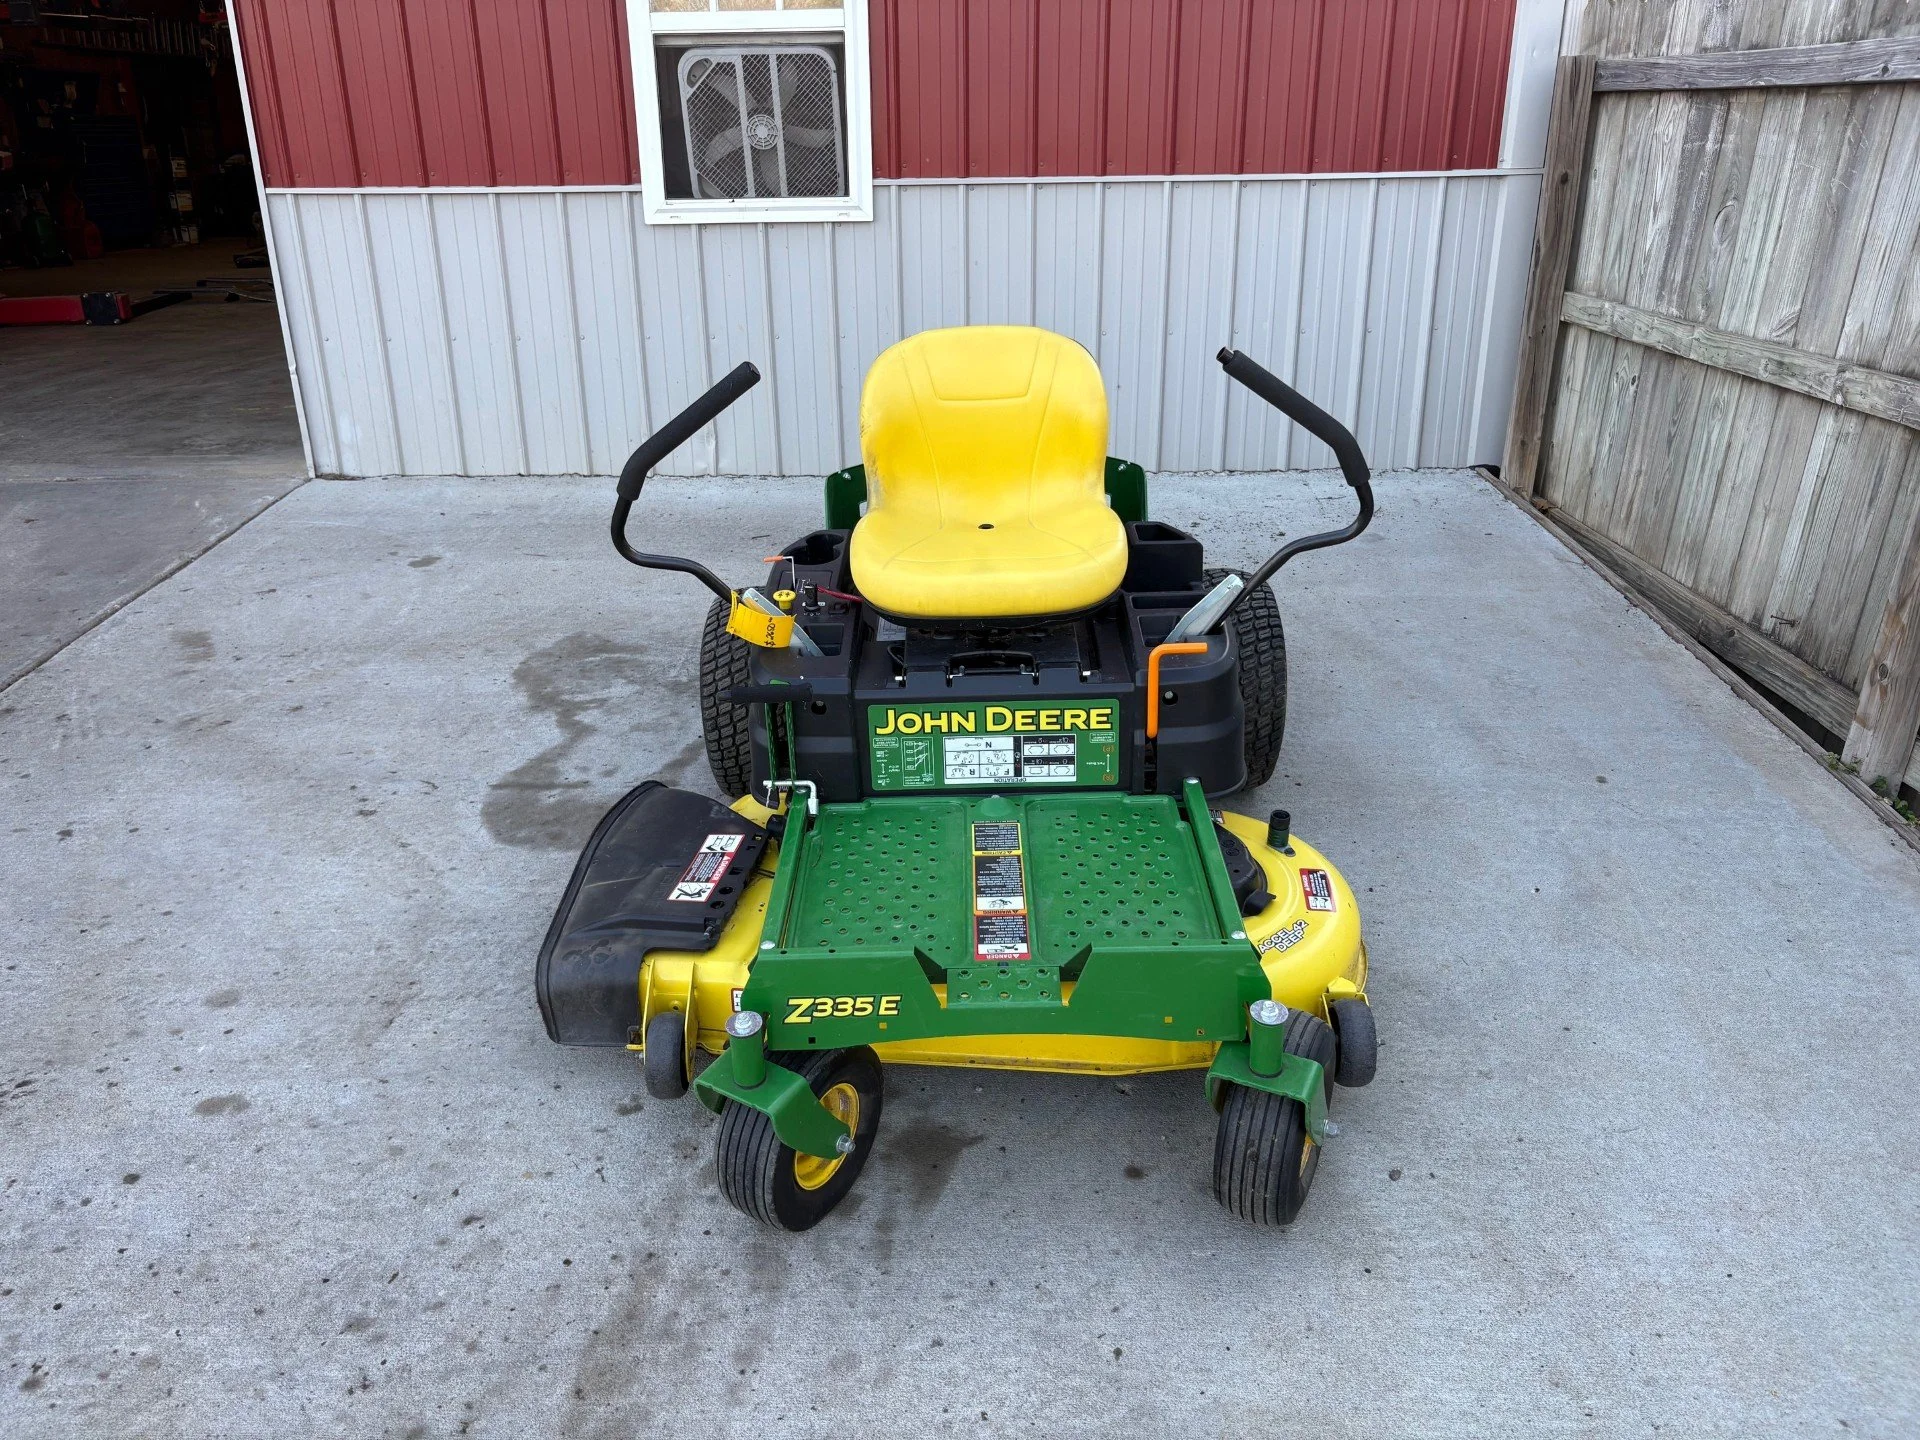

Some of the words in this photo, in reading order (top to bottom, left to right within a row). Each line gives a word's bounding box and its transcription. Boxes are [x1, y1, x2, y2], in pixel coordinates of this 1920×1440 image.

[876, 708, 976, 735] JOHN
[985, 706, 1112, 733] DEERE
[712, 860, 729, 881] DANGER
[1257, 927, 1295, 954] ACCEL
[1292, 919, 1309, 932] 42
[1275, 930, 1305, 953] DEEP
